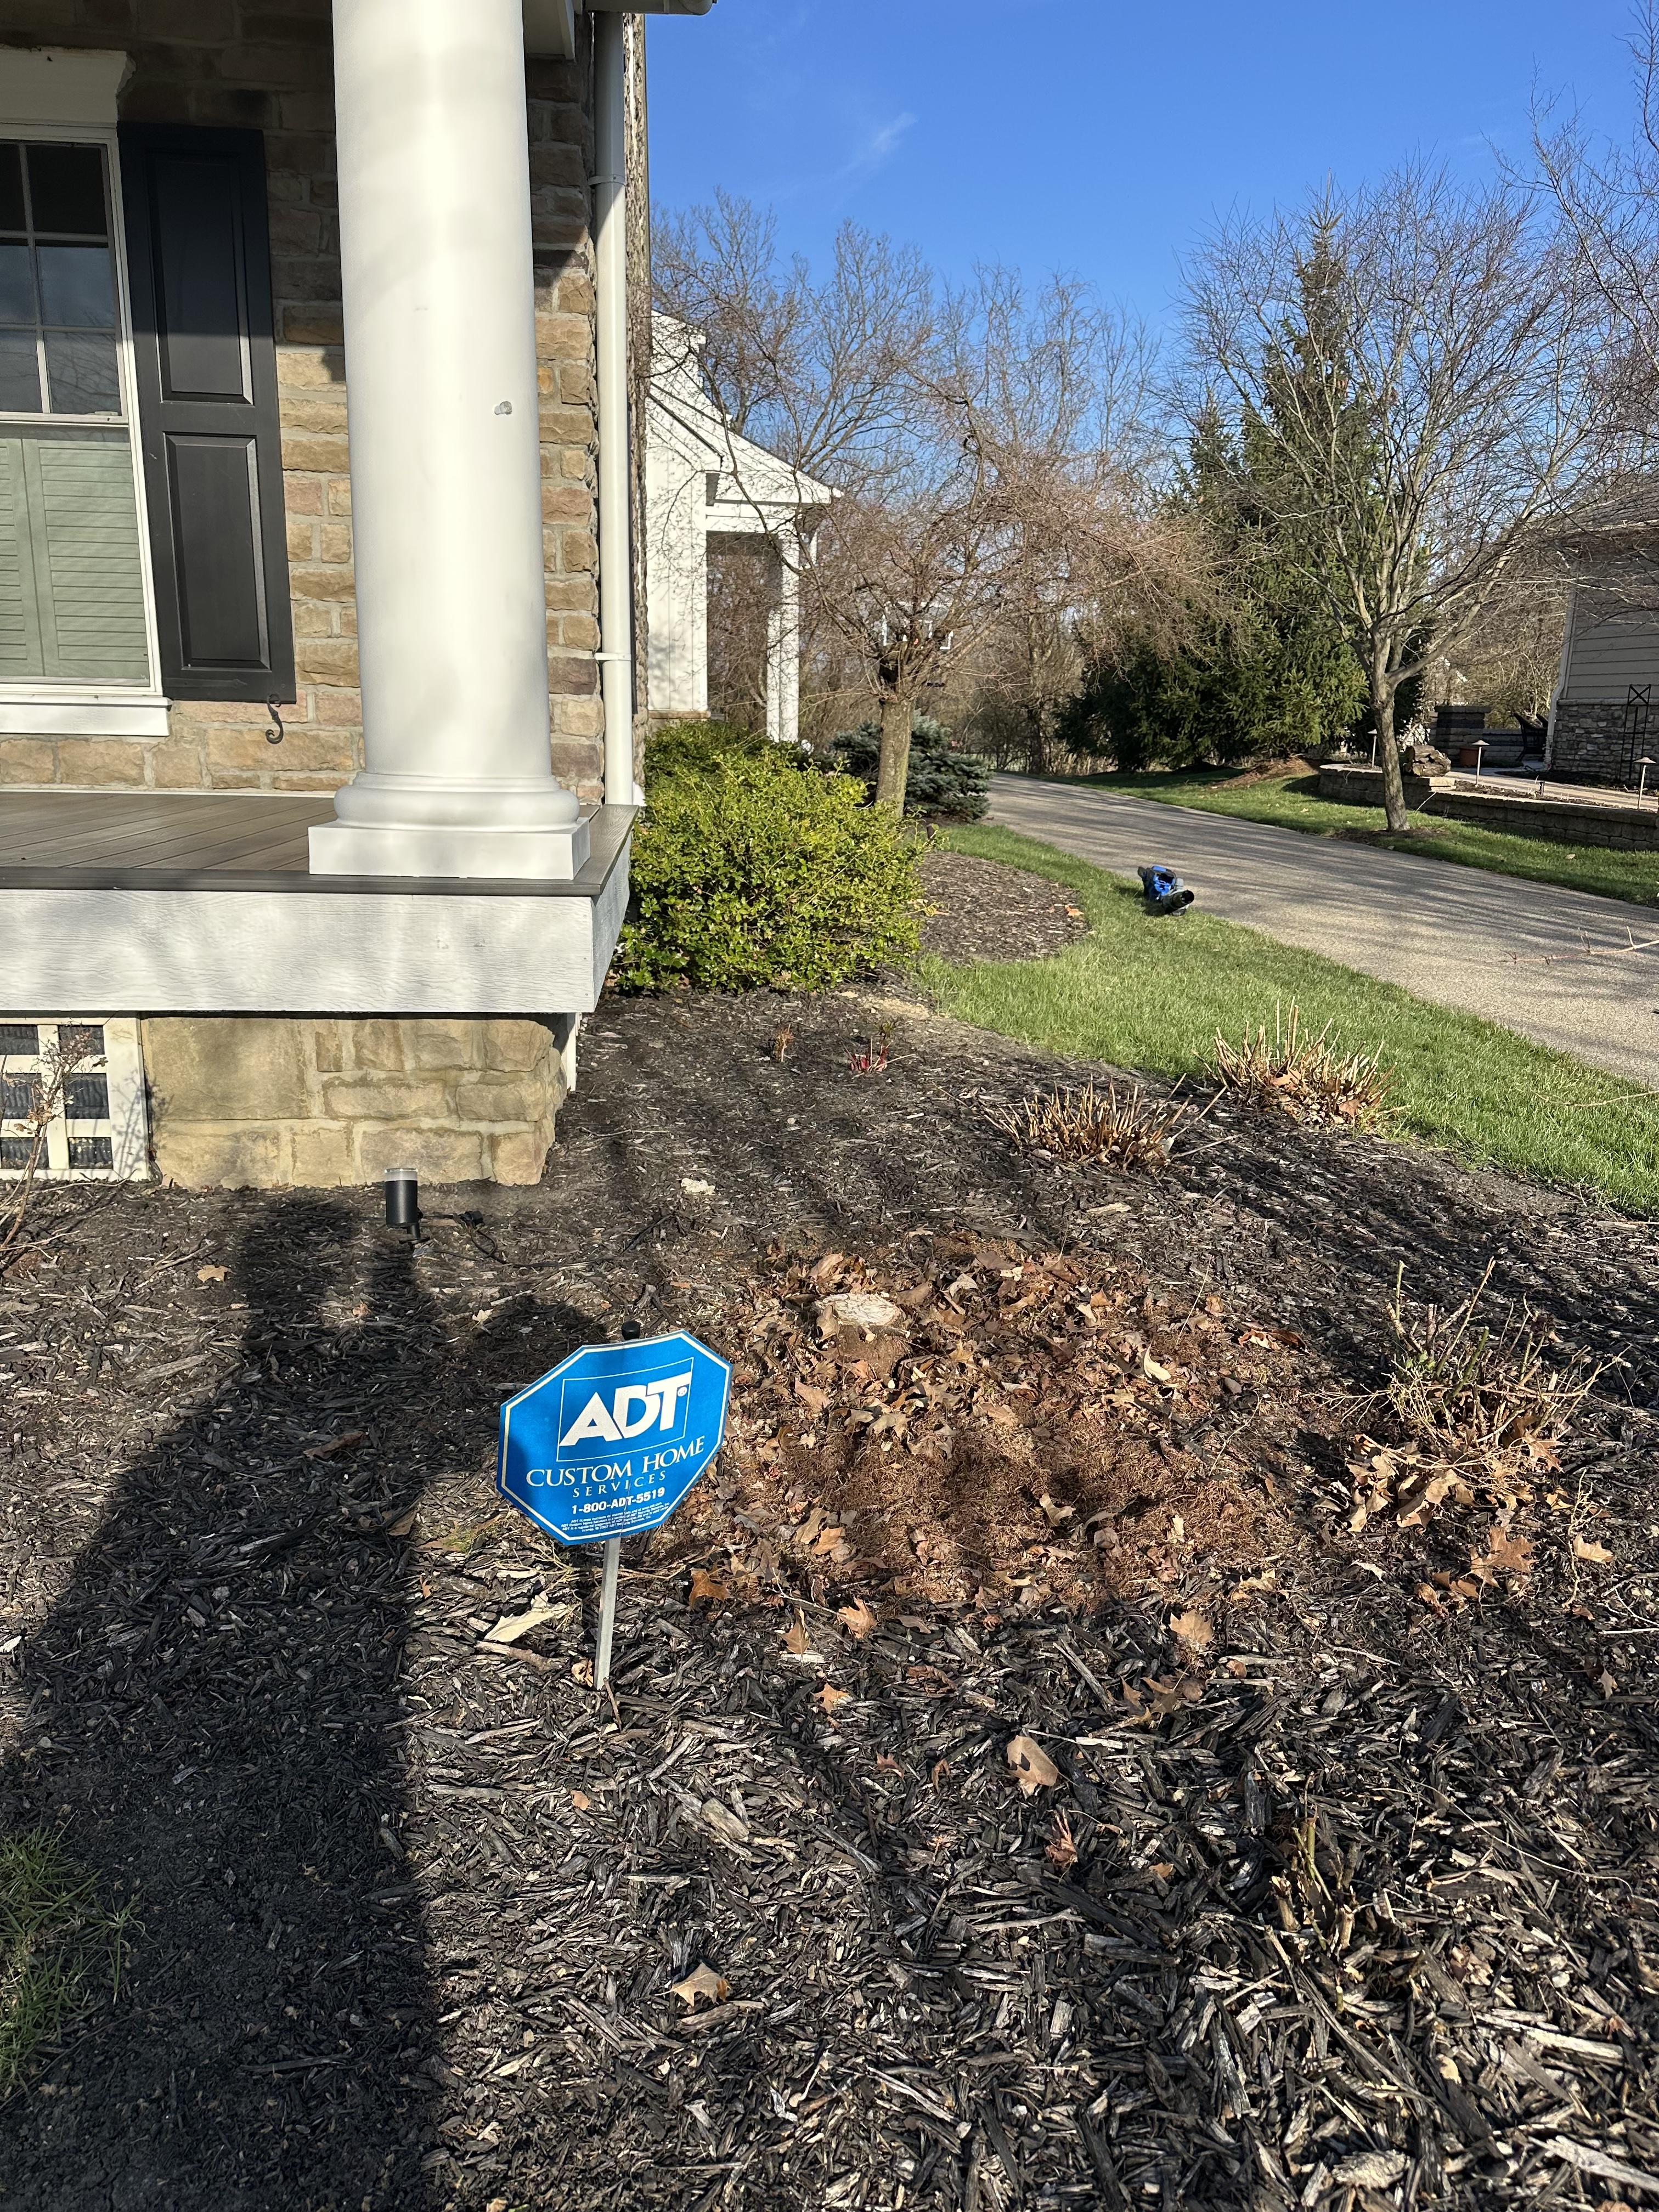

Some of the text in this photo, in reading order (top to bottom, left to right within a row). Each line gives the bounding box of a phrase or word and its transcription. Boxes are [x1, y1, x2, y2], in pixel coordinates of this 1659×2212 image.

[559, 1372, 692, 1446] ADT
[526, 1435, 705, 1487] CUSTOM HOME
[572, 1487, 665, 1515] 1-800-ADT-5519
[573, 1470, 666, 1498] SERVICES
